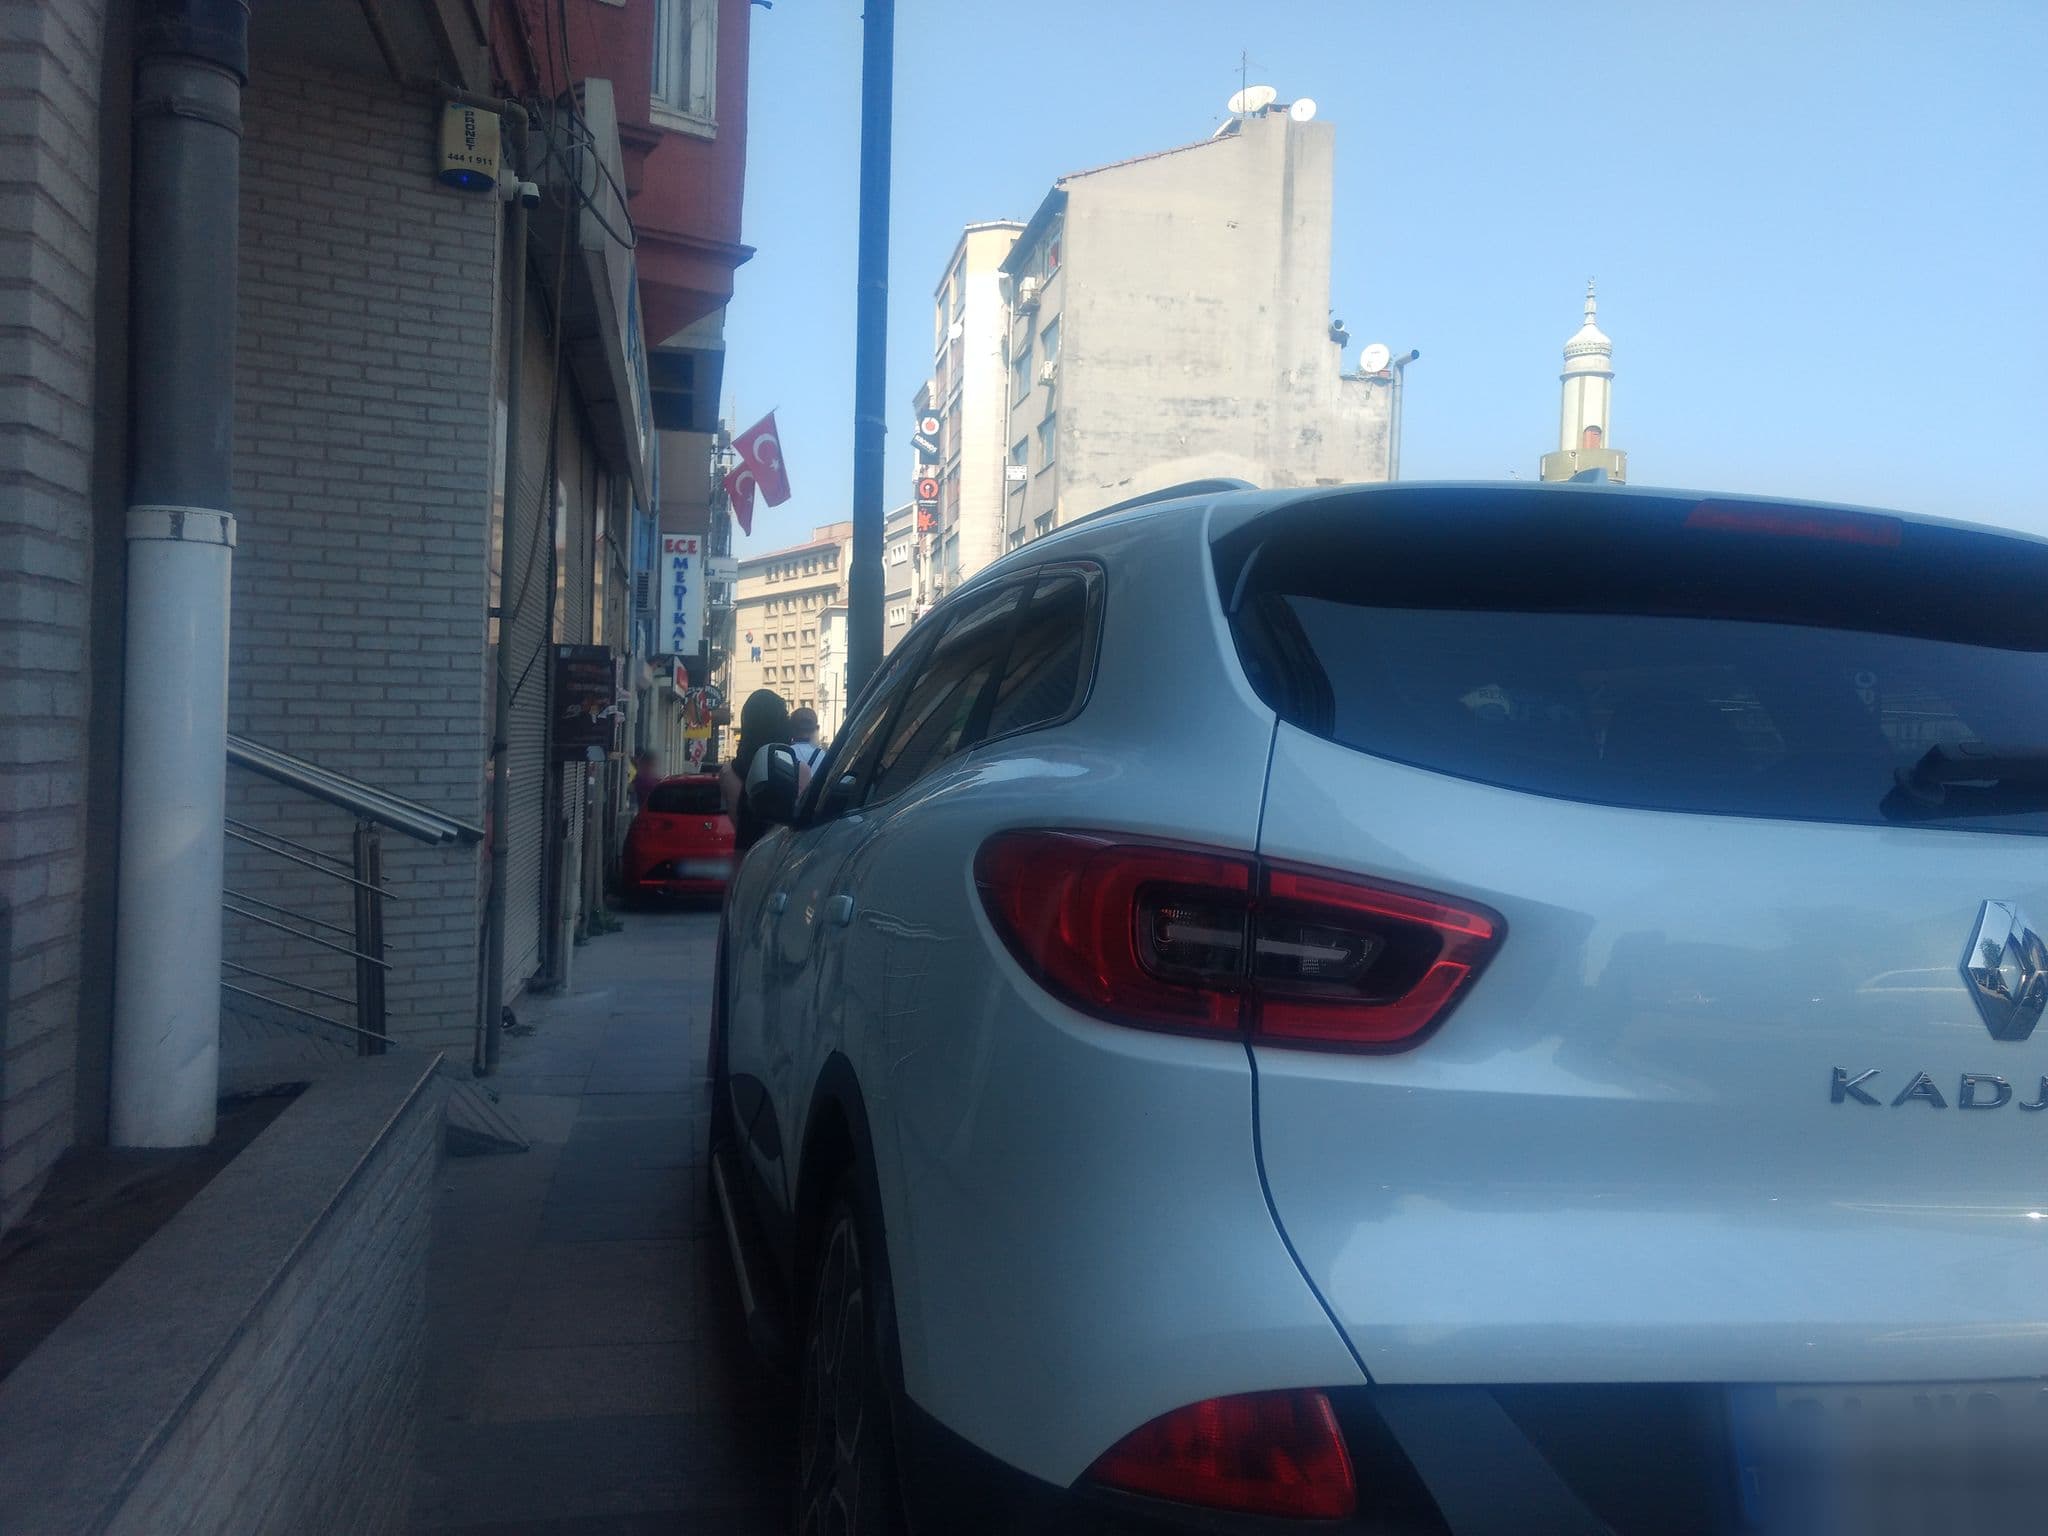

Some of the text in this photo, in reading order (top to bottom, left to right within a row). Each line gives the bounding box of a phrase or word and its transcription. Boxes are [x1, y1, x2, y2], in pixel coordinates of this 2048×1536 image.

[465, 111, 475, 150] PRONET
[448, 153, 465, 162] 444
[476, 157, 492, 166] 911
[664, 538, 698, 554] ECE
